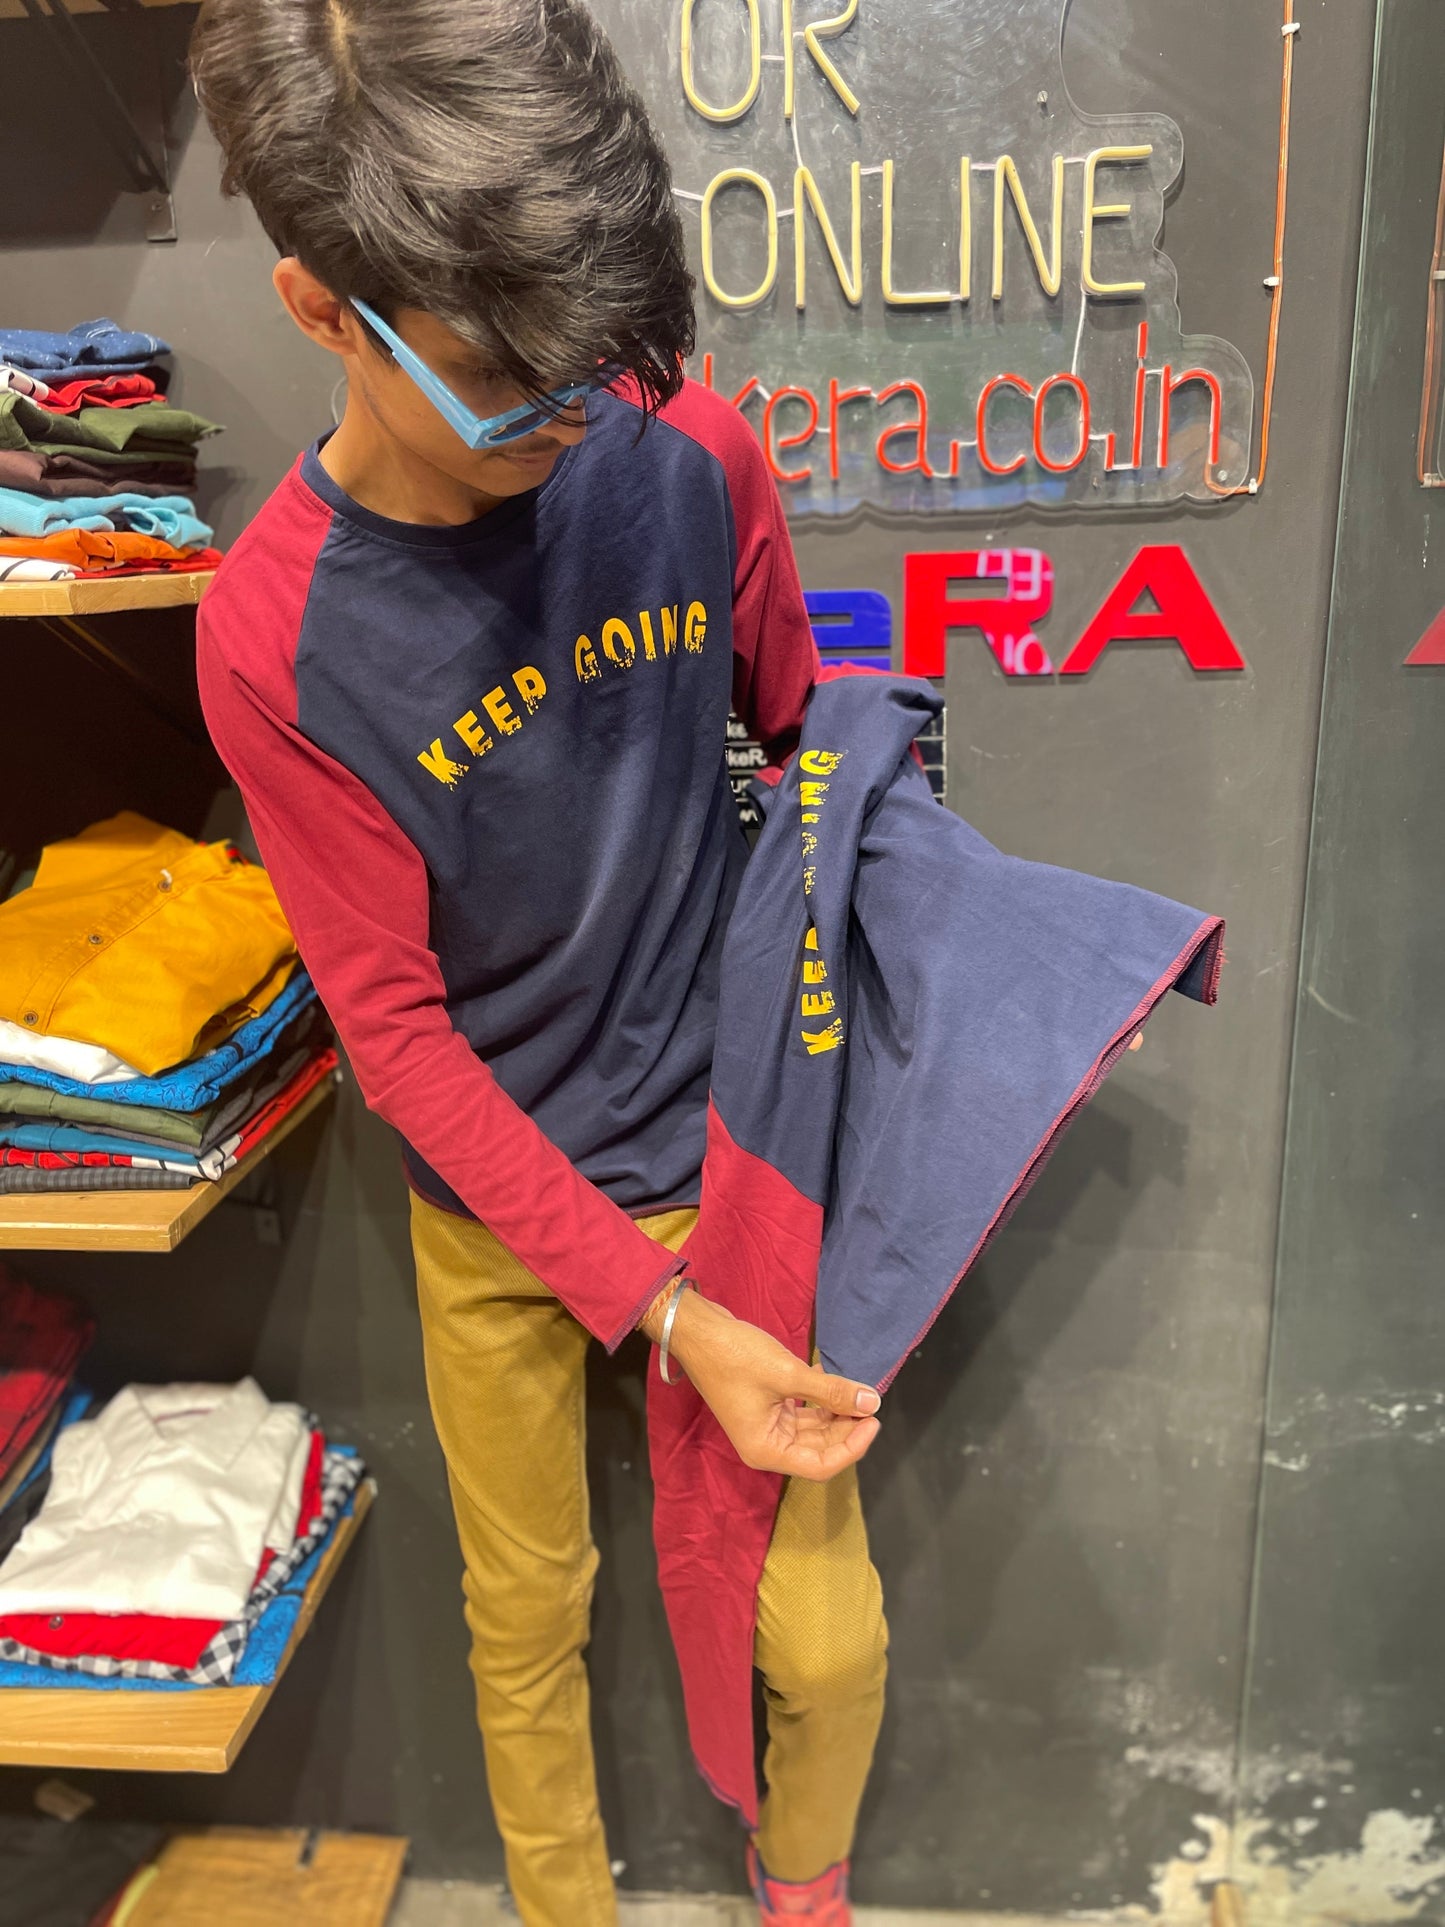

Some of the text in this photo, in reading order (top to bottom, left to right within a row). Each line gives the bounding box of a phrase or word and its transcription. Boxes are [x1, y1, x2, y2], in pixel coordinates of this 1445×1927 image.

[681, 0, 860, 122] OR
[701, 144, 1153, 308] ONLINE
[416, 600, 707, 791] KEEP GOING
